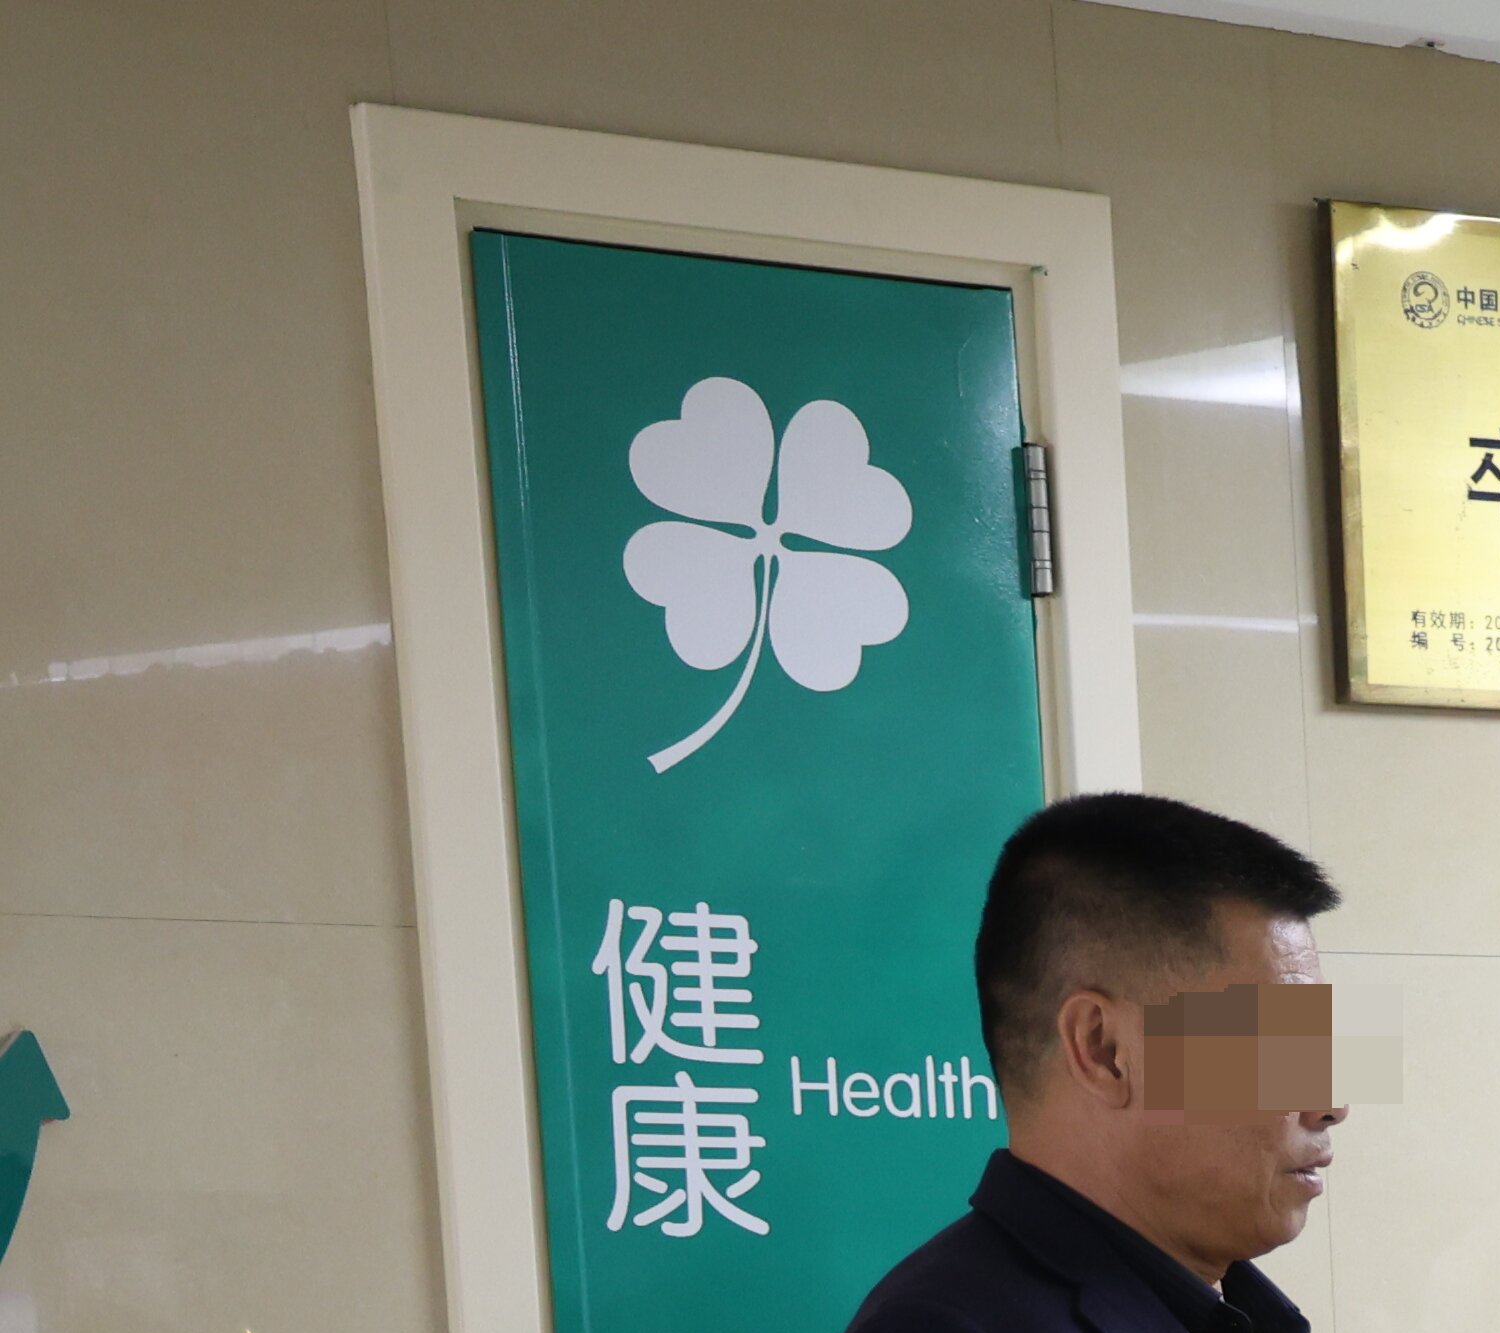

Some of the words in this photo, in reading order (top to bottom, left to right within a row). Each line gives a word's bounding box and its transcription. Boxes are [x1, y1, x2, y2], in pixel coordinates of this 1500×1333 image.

[1457, 314, 1494, 328] CHINESE
[591, 898, 770, 1237] 健康
[790, 1055, 998, 1120] Health
